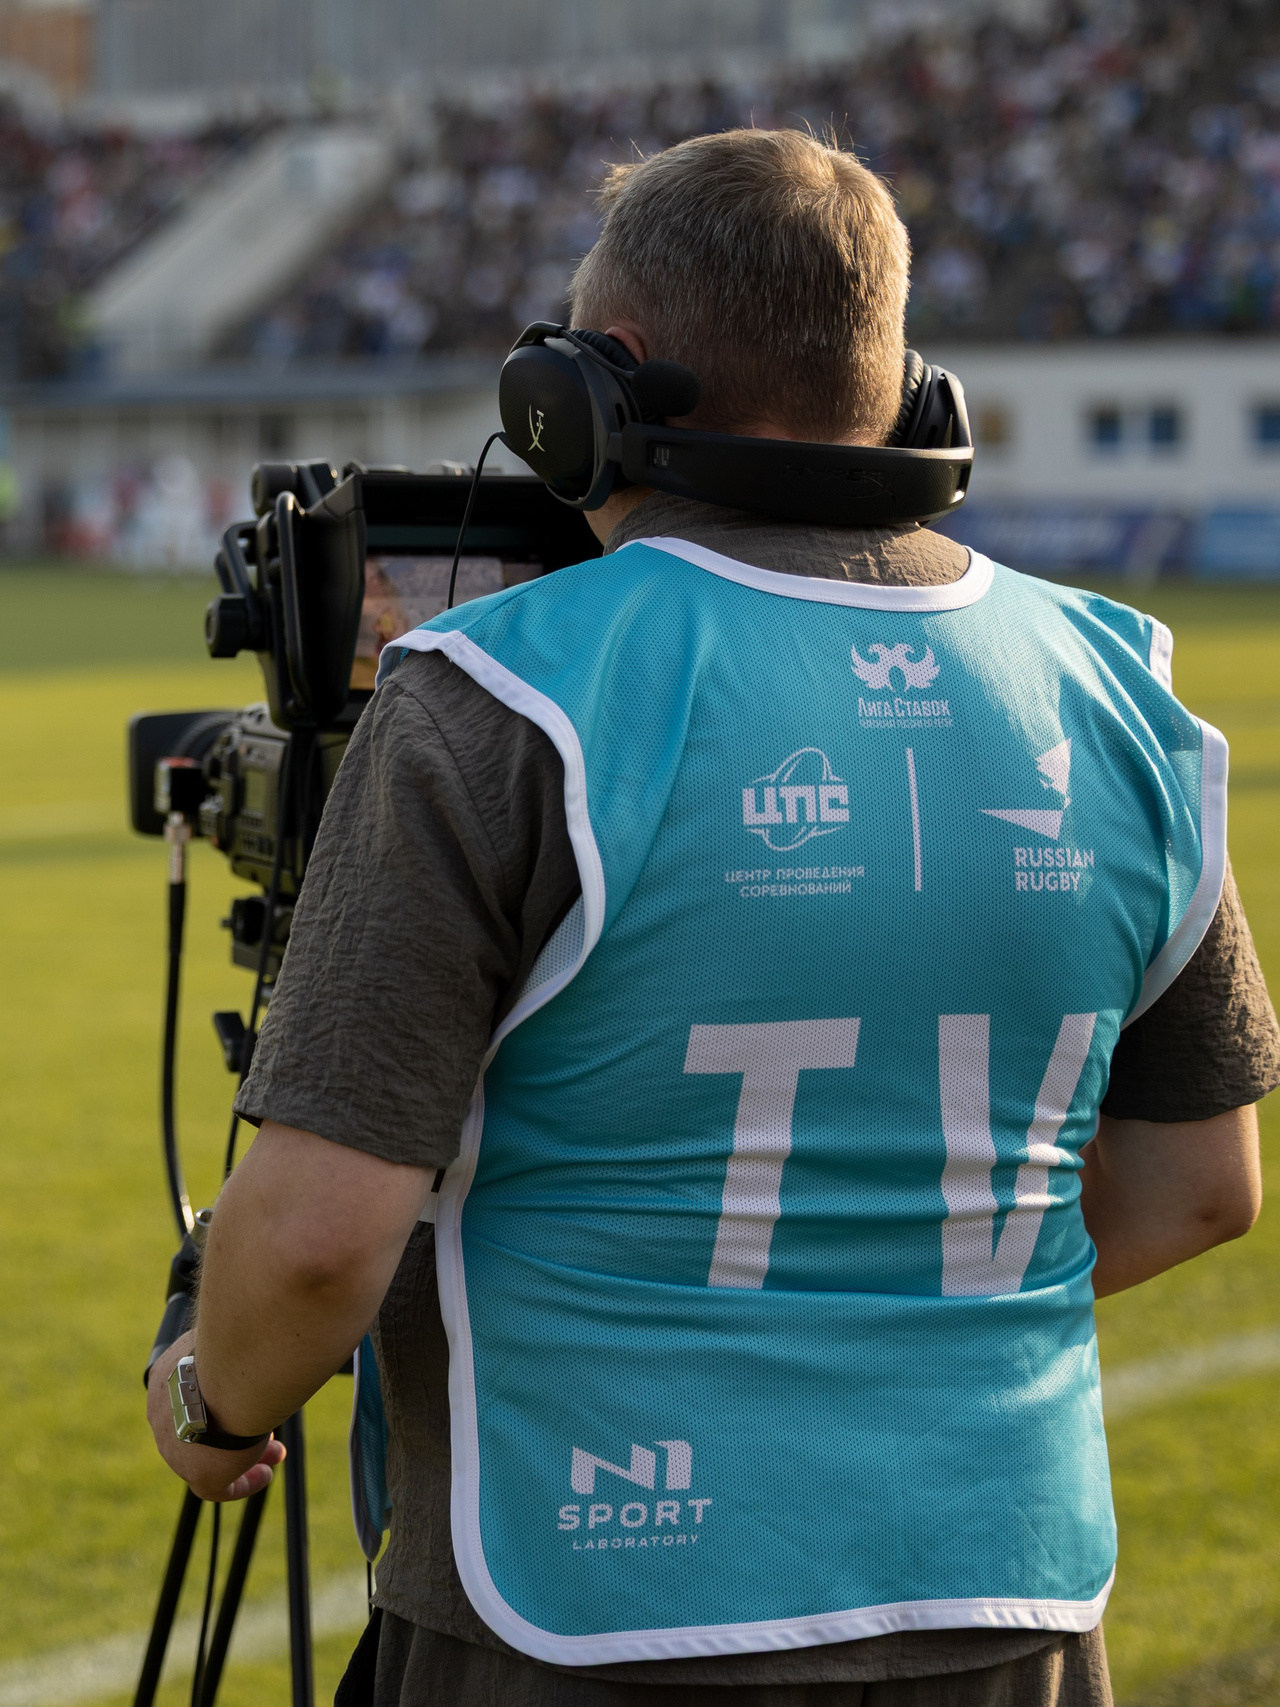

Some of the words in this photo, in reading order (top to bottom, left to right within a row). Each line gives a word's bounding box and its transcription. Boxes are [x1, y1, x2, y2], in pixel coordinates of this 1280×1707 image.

[742, 785, 850, 825] ЦПС
[1013, 847, 1095, 868] RUSSIAN
[724, 869, 771, 882] ЦЕНТР
[775, 865, 865, 881] ПРОВЕДЕНИЯ
[1015, 871, 1081, 892] RUGBY
[740, 879, 852, 898] СОРЕВНОВАНИЙ
[683, 1012, 1098, 1297] TV
[557, 1498, 713, 1530] SPORT
[573, 1534, 699, 1550] LABORATORY
